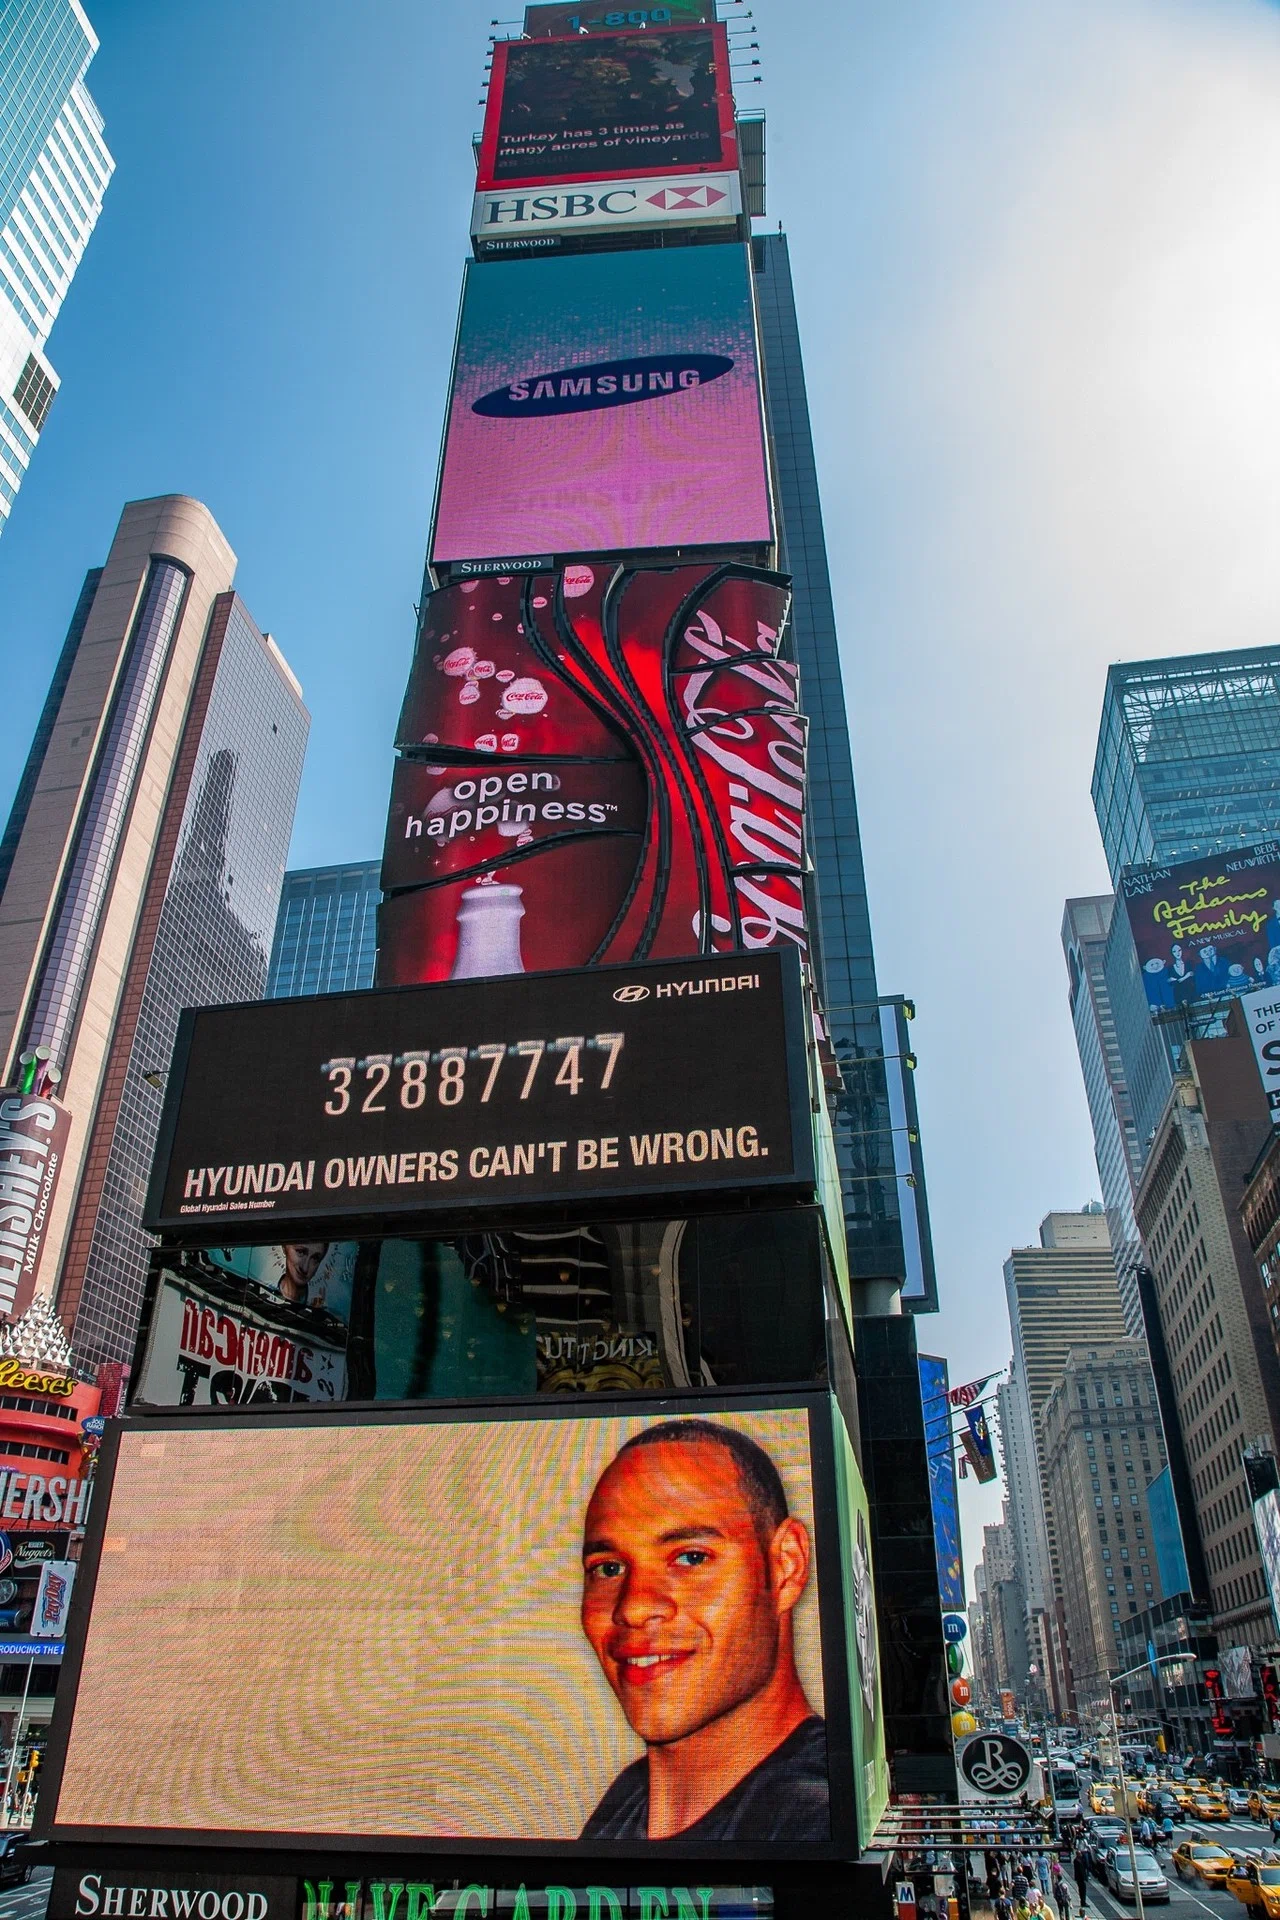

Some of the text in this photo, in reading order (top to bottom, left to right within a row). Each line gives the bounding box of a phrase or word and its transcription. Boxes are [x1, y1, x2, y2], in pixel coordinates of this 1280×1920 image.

[566, 8, 671, 29] 1-800
[501, 121, 685, 143] Turkey has 3 times as
[499, 131, 710, 156] many acres of vineyards
[484, 189, 637, 224] HSBC
[485, 238, 555, 250] SHERWOOD
[508, 369, 701, 401] SAMSUNG
[461, 560, 542, 573] SHERWOOD
[453, 771, 553, 803] open
[1254, 841, 1279, 856] BEBE
[1122, 868, 1172, 888] NATHAN
[1179, 875, 1231, 896] The
[1125, 883, 1154, 898] LANE
[1153, 887, 1268, 922] Addams
[1167, 908, 1268, 939] Family
[1196, 936, 1212, 945] NEW
[1213, 928, 1247, 942] MUSICAL
[655, 974, 761, 999] HYUNDAI
[1255, 1020, 1276, 1034] OF
[328, 1032, 625, 1116] 32887747
[183, 1124, 769, 1198] HYUNDAI OWNERS CAN'T BE WRONG.
[23, 1152, 59, 1274] Milk Chocolate
[180, 1199, 276, 1213] Global Hyundai Sales Number
[15, 1545, 53, 1560] Nuggets
[947, 1622, 959, 1633] m
[42, 1645, 59, 1655] THE
[959, 1685, 969, 1697] m
[75, 1874, 268, 1920] SHERWOOD
